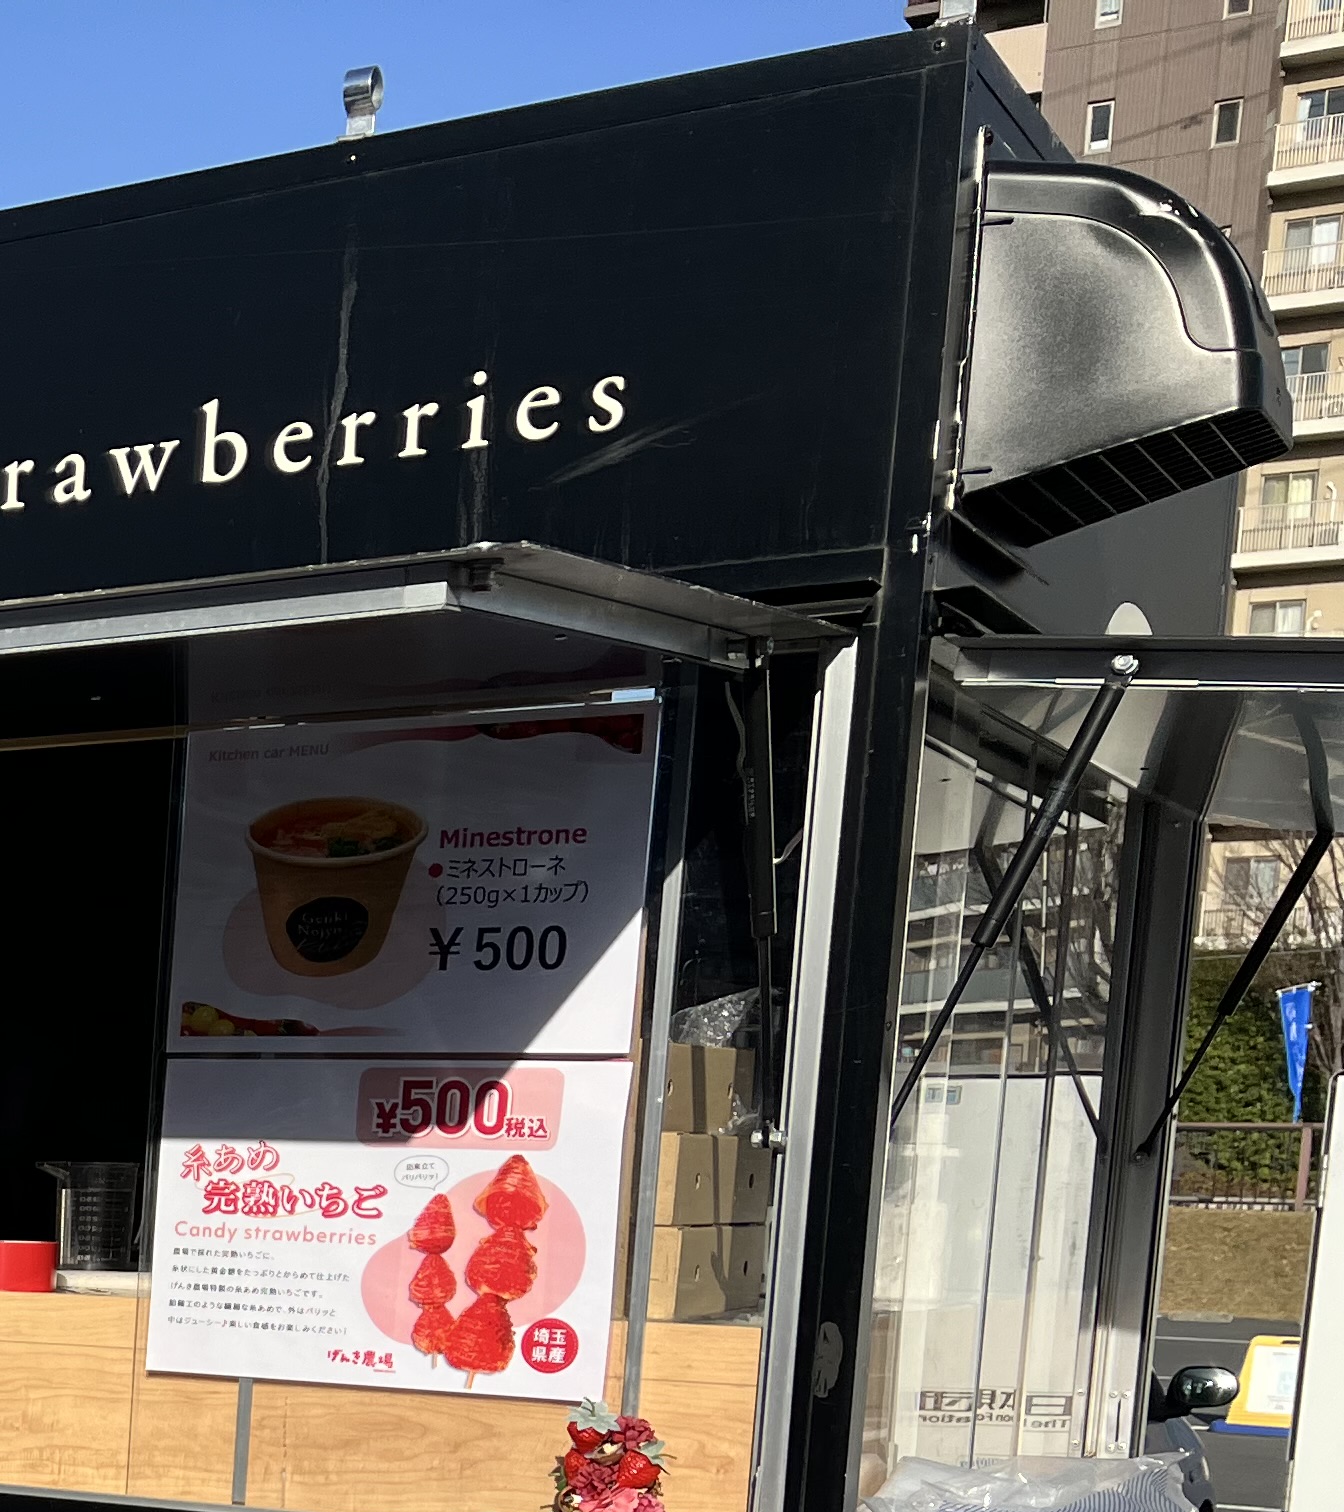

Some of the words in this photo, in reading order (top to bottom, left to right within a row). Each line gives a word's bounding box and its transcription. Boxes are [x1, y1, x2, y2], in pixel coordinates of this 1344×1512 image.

[208, 748, 259, 763] Kitchen
[263, 748, 284, 760] car
[288, 743, 330, 758] MENU
[438, 824, 588, 850] Minestrone
[446, 854, 567, 879] ミネストローネ
[180, 1141, 281, 1182] 糸あめ
[202, 1179, 388, 1220] 完熟いちご
[174, 1221, 239, 1241] Candy
[244, 1224, 377, 1246] strawberries
[531, 1327, 568, 1346] 埼玉
[530, 1346, 567, 1364] 県産
